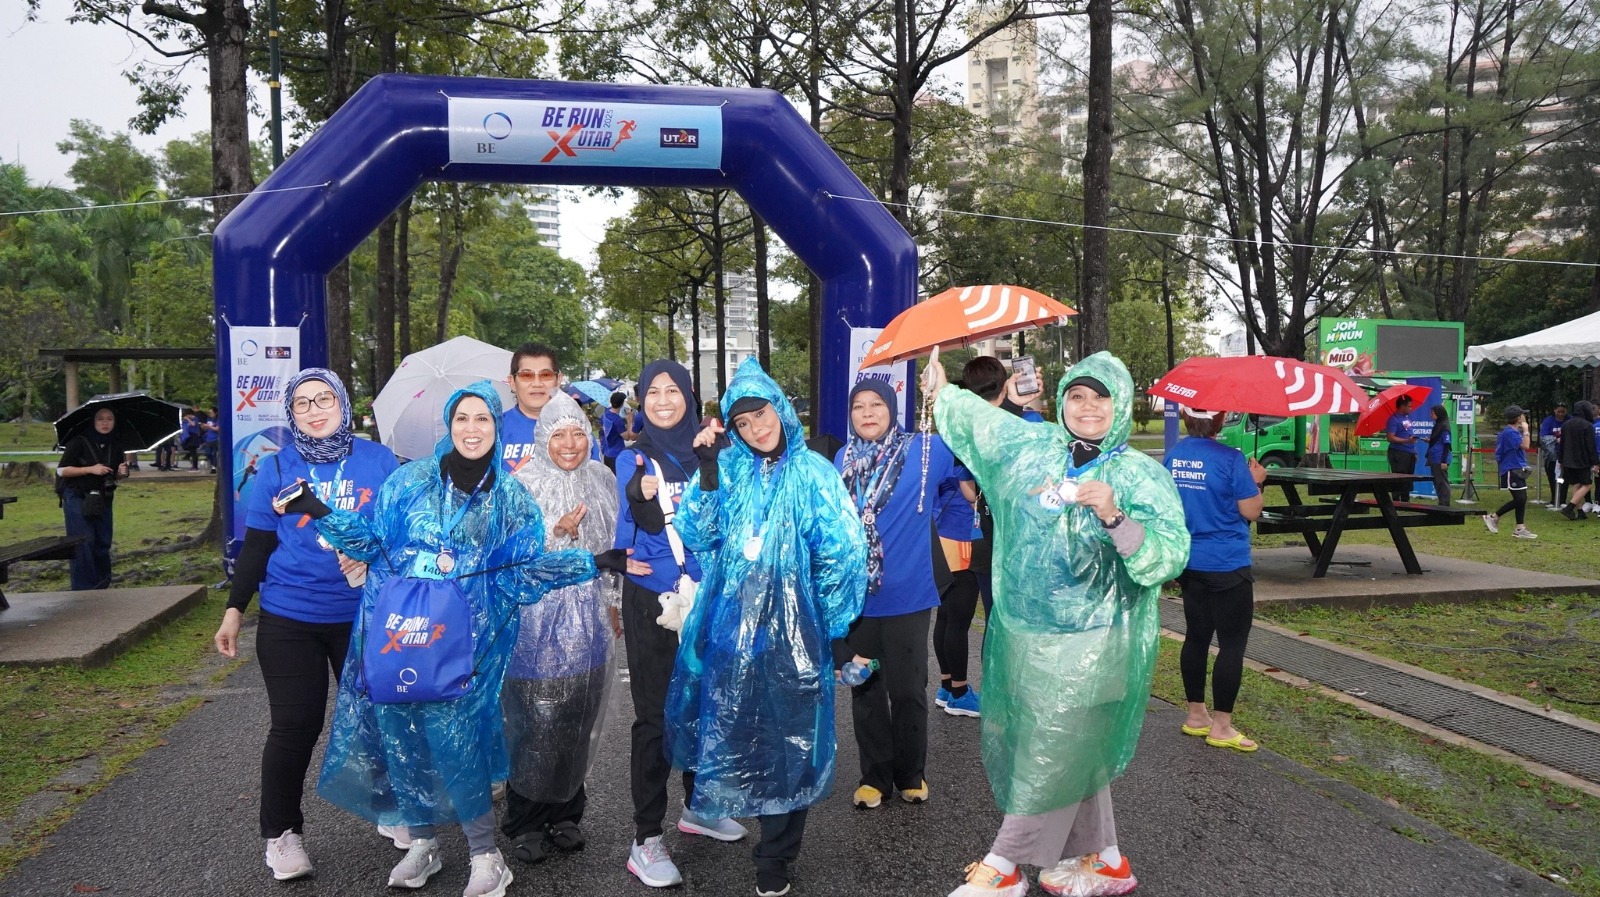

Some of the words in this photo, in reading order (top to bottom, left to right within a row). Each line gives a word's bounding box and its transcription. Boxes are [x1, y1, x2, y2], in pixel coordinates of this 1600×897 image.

[542, 107, 567, 128] BE
[567, 108, 606, 129] RUN
[604, 110, 614, 128] 2025
[578, 131, 613, 147] UTAR
[477, 143, 496, 154] BE
[1333, 321, 1357, 331] JOM
[238, 358, 249, 366] BE
[1329, 354, 1354, 363] MILO
[237, 376, 250, 389] BE
[251, 376, 276, 389] RUN
[257, 391, 280, 401] UTAR
[503, 444, 521, 459] BE
[1172, 459, 1204, 469] BEYOND
[1172, 470, 1207, 481] ETERNITY
[346, 480, 354, 496] 2025
[336, 497, 356, 510] TAR
[423, 565, 448, 579] 140
[385, 613, 404, 630] BE
[399, 616, 424, 632] RUN
[402, 633, 429, 645] UTAR
[397, 685, 409, 693] BE
